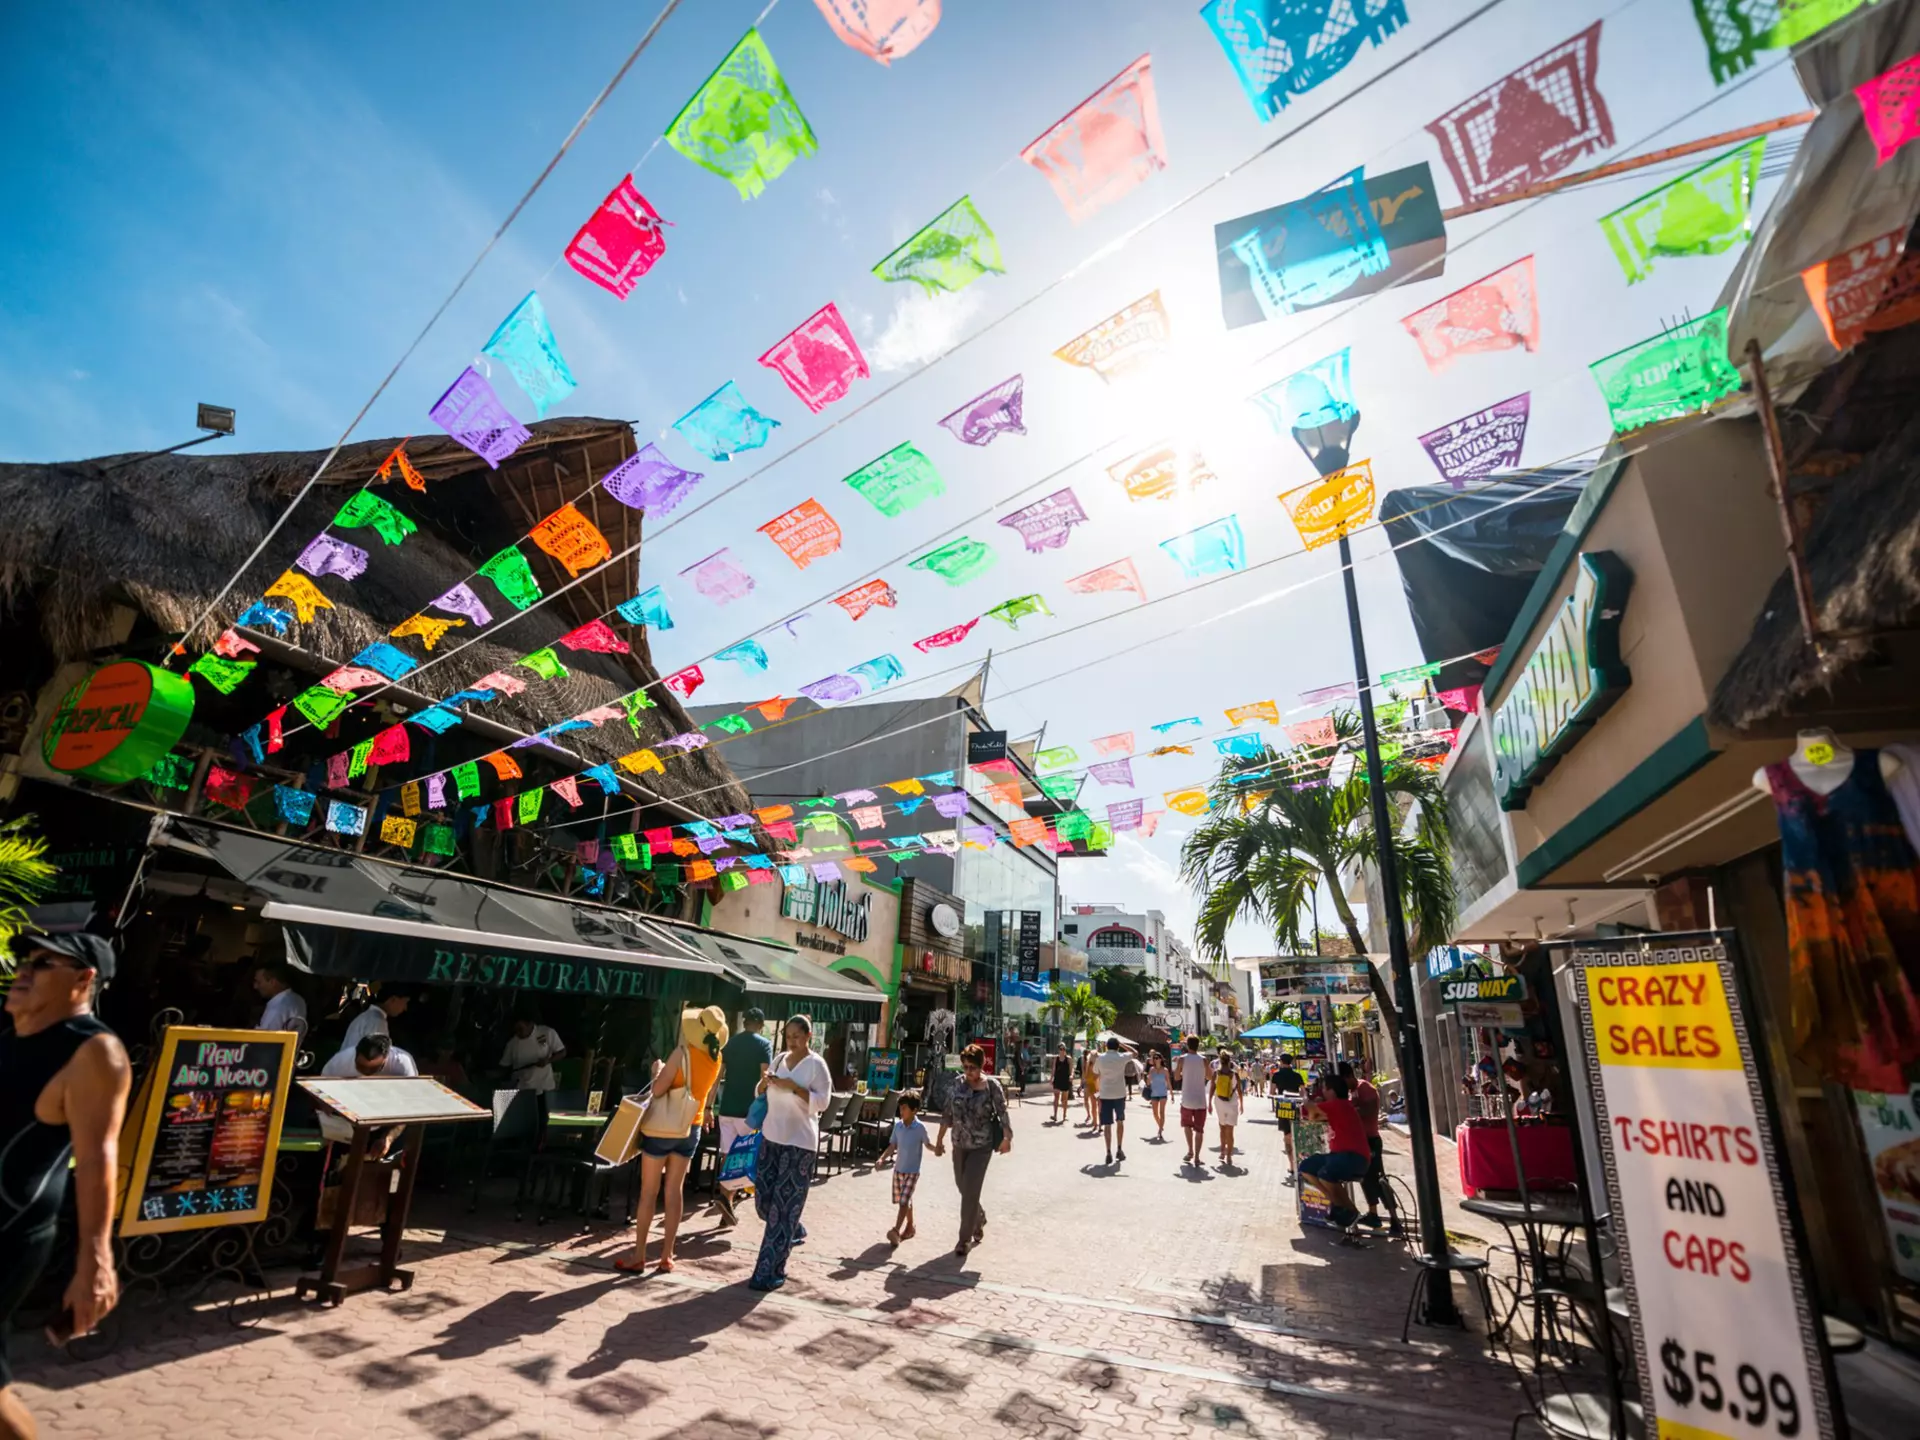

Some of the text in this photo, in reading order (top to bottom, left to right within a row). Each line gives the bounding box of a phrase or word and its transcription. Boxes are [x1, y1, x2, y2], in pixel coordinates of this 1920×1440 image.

[1491, 554, 1598, 800] SUBWAY
[52, 848, 136, 869] RESTAURAT
[427, 950, 644, 996] RESTAURANTE
[1442, 976, 1517, 1000] SUBWAY
[1598, 974, 1706, 1006] CRAZY
[788, 1000, 855, 1022] MEXICANO
[1609, 1024, 1721, 1059] SALES
[1614, 1116, 1759, 1166] T-SHIRTS
[1666, 1176, 1726, 1218] AND
[1663, 1229, 1752, 1284] CAPS
[1659, 1337, 1801, 1438] $5.99
